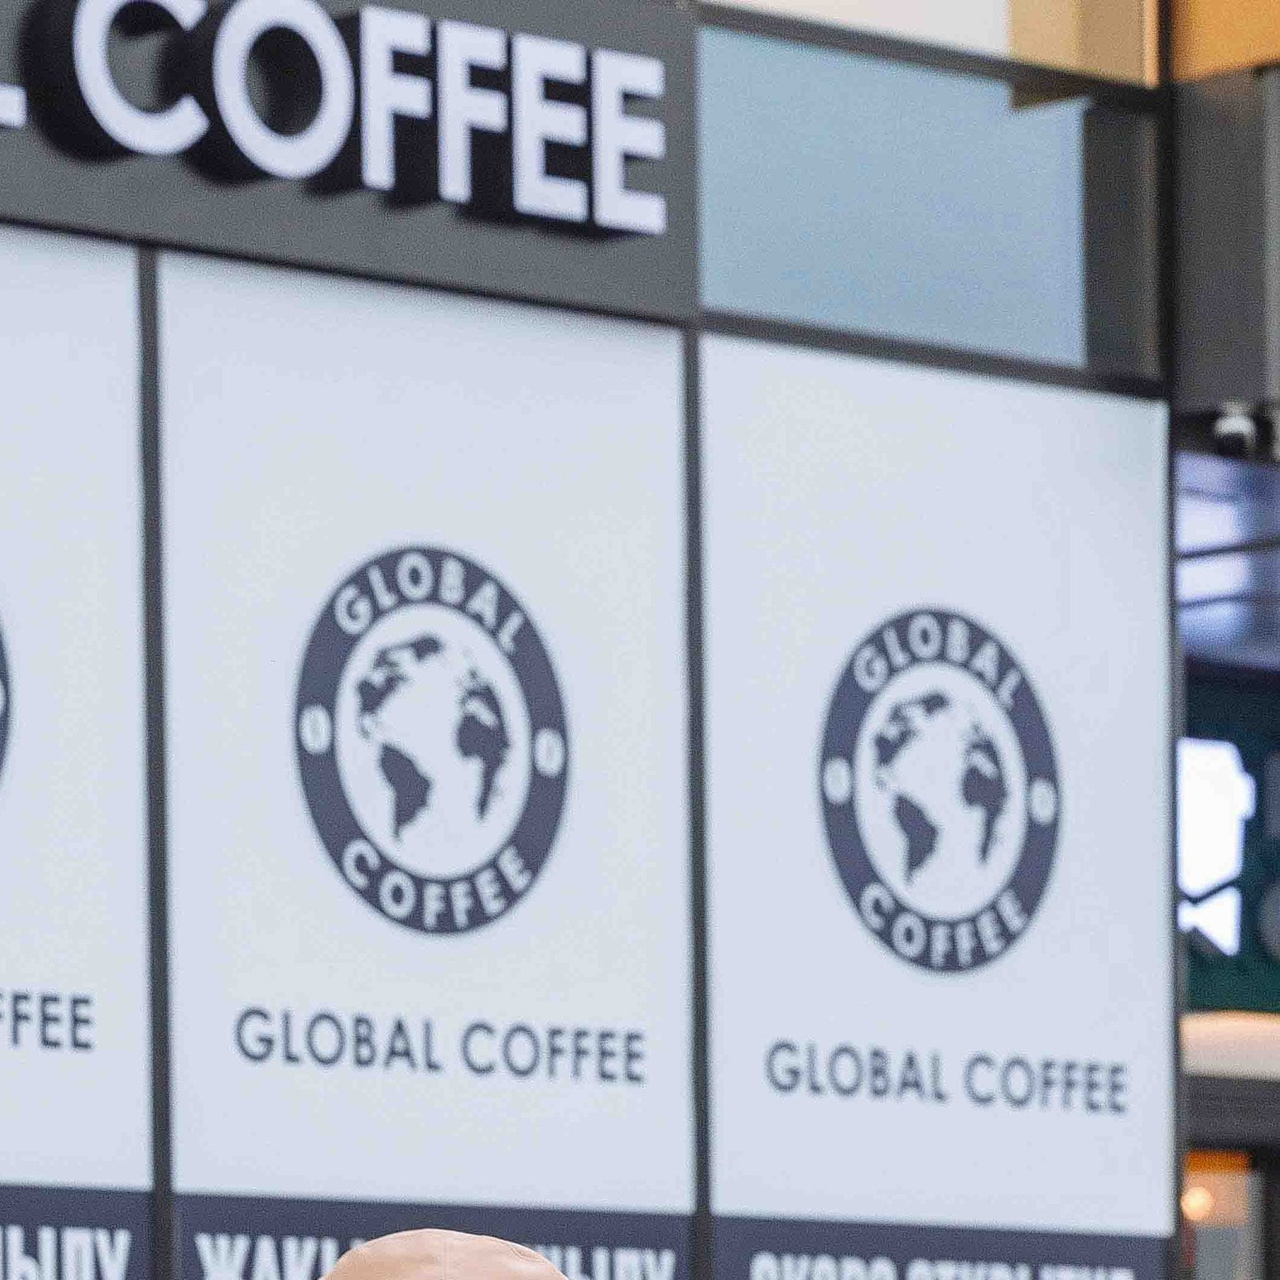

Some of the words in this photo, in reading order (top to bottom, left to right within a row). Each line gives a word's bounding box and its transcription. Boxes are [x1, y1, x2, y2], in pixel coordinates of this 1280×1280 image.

[72, 0, 666, 236] COFFEE
[333, 553, 524, 655] GLOBAL
[853, 612, 1025, 709] GLOBAL
[341, 838, 534, 930] COFFEE
[860, 882, 1030, 968] COFFEE
[235, 1006, 443, 1073] GLOBAL
[461, 1022, 647, 1084] COFFEE
[766, 1038, 950, 1104] GLOBAL
[963, 1054, 1130, 1115] COFFEE
